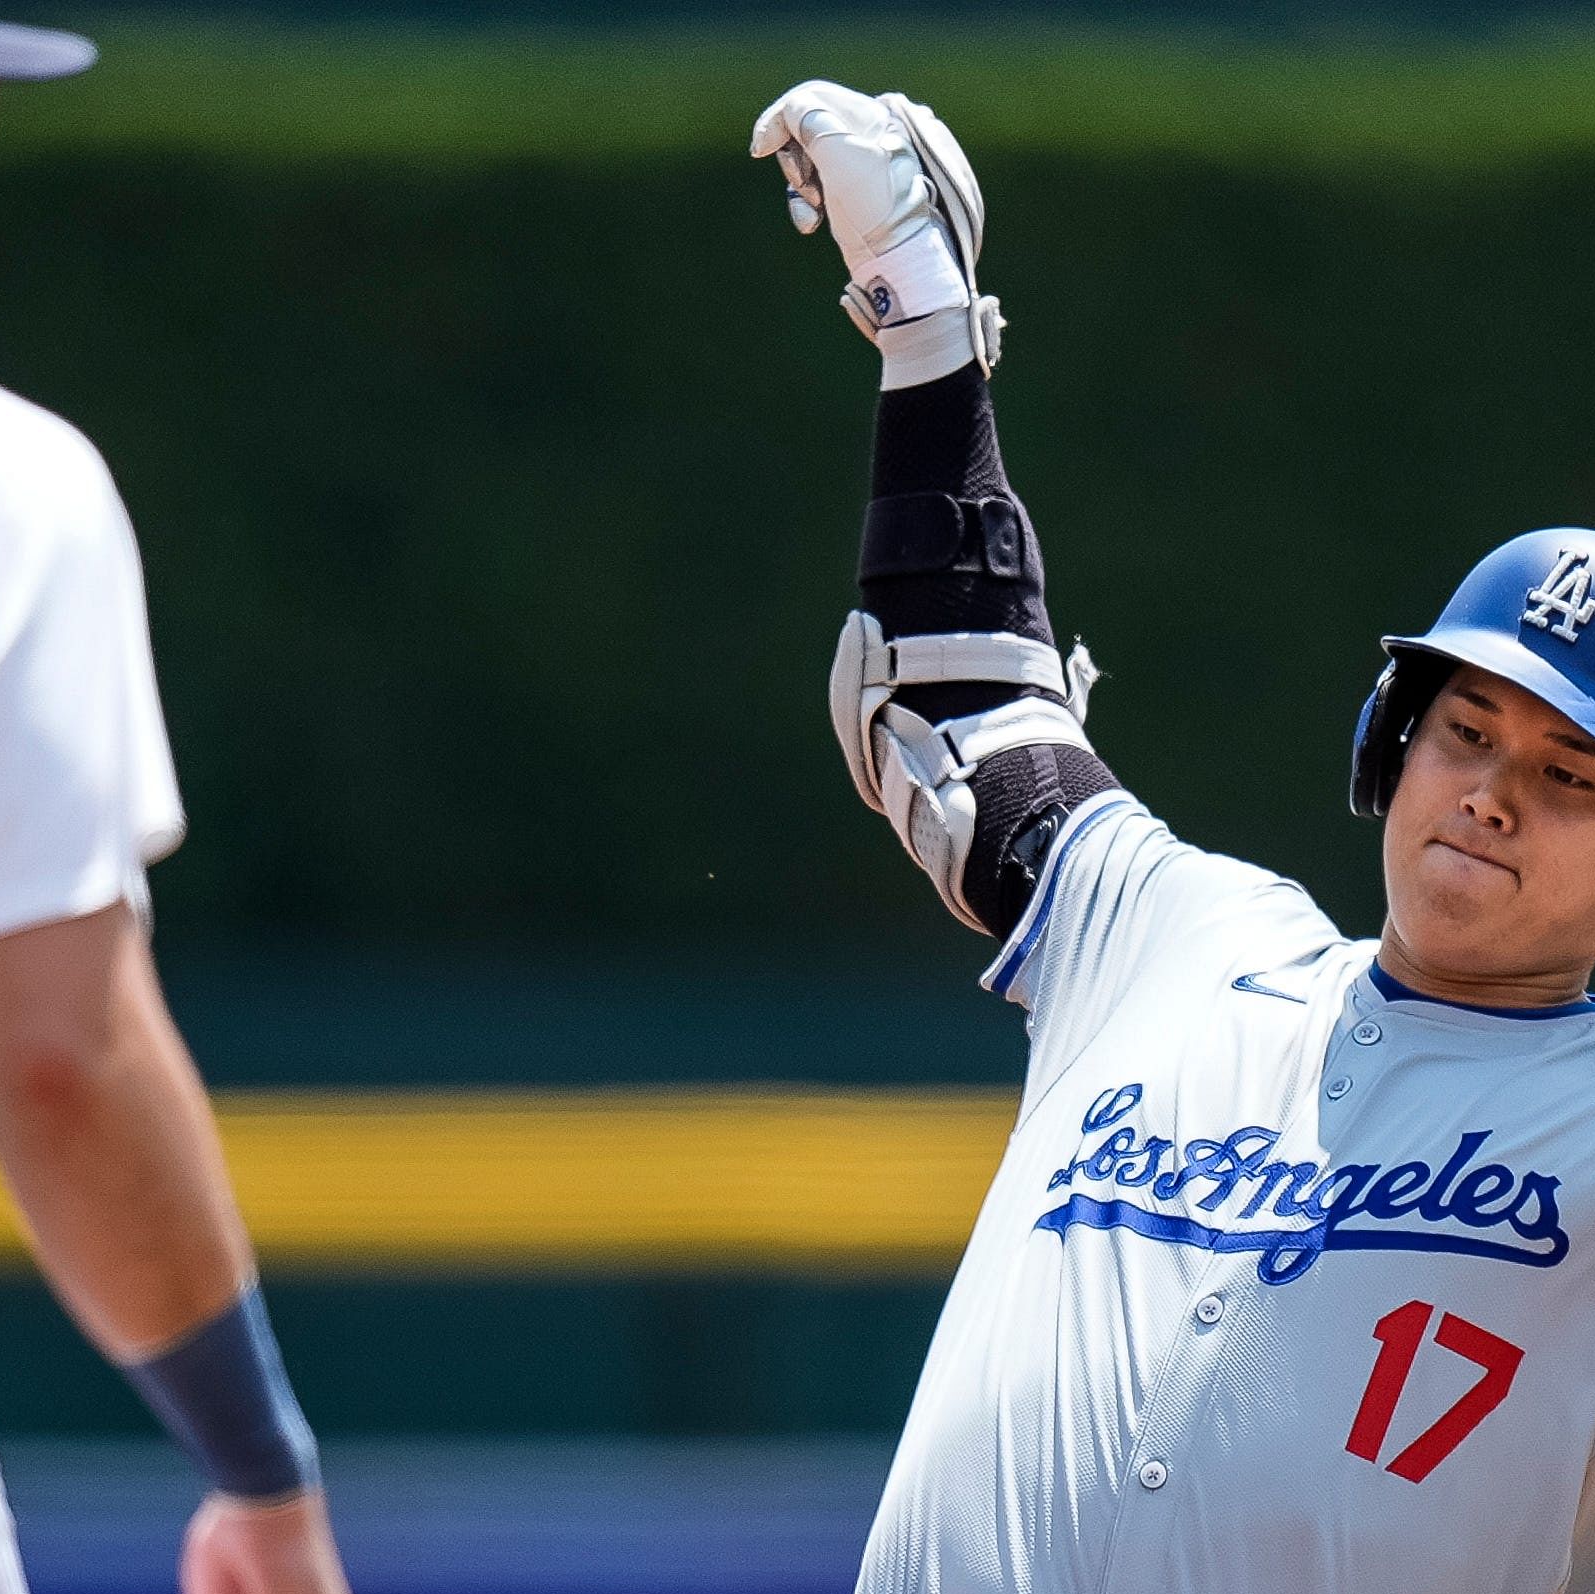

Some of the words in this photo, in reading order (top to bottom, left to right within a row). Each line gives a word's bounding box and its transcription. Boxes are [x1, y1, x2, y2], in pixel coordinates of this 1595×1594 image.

[1046, 1082, 1175, 1193] Los
[1152, 1126, 1568, 1286] Angeles
[1346, 1302, 1524, 1483] 17
